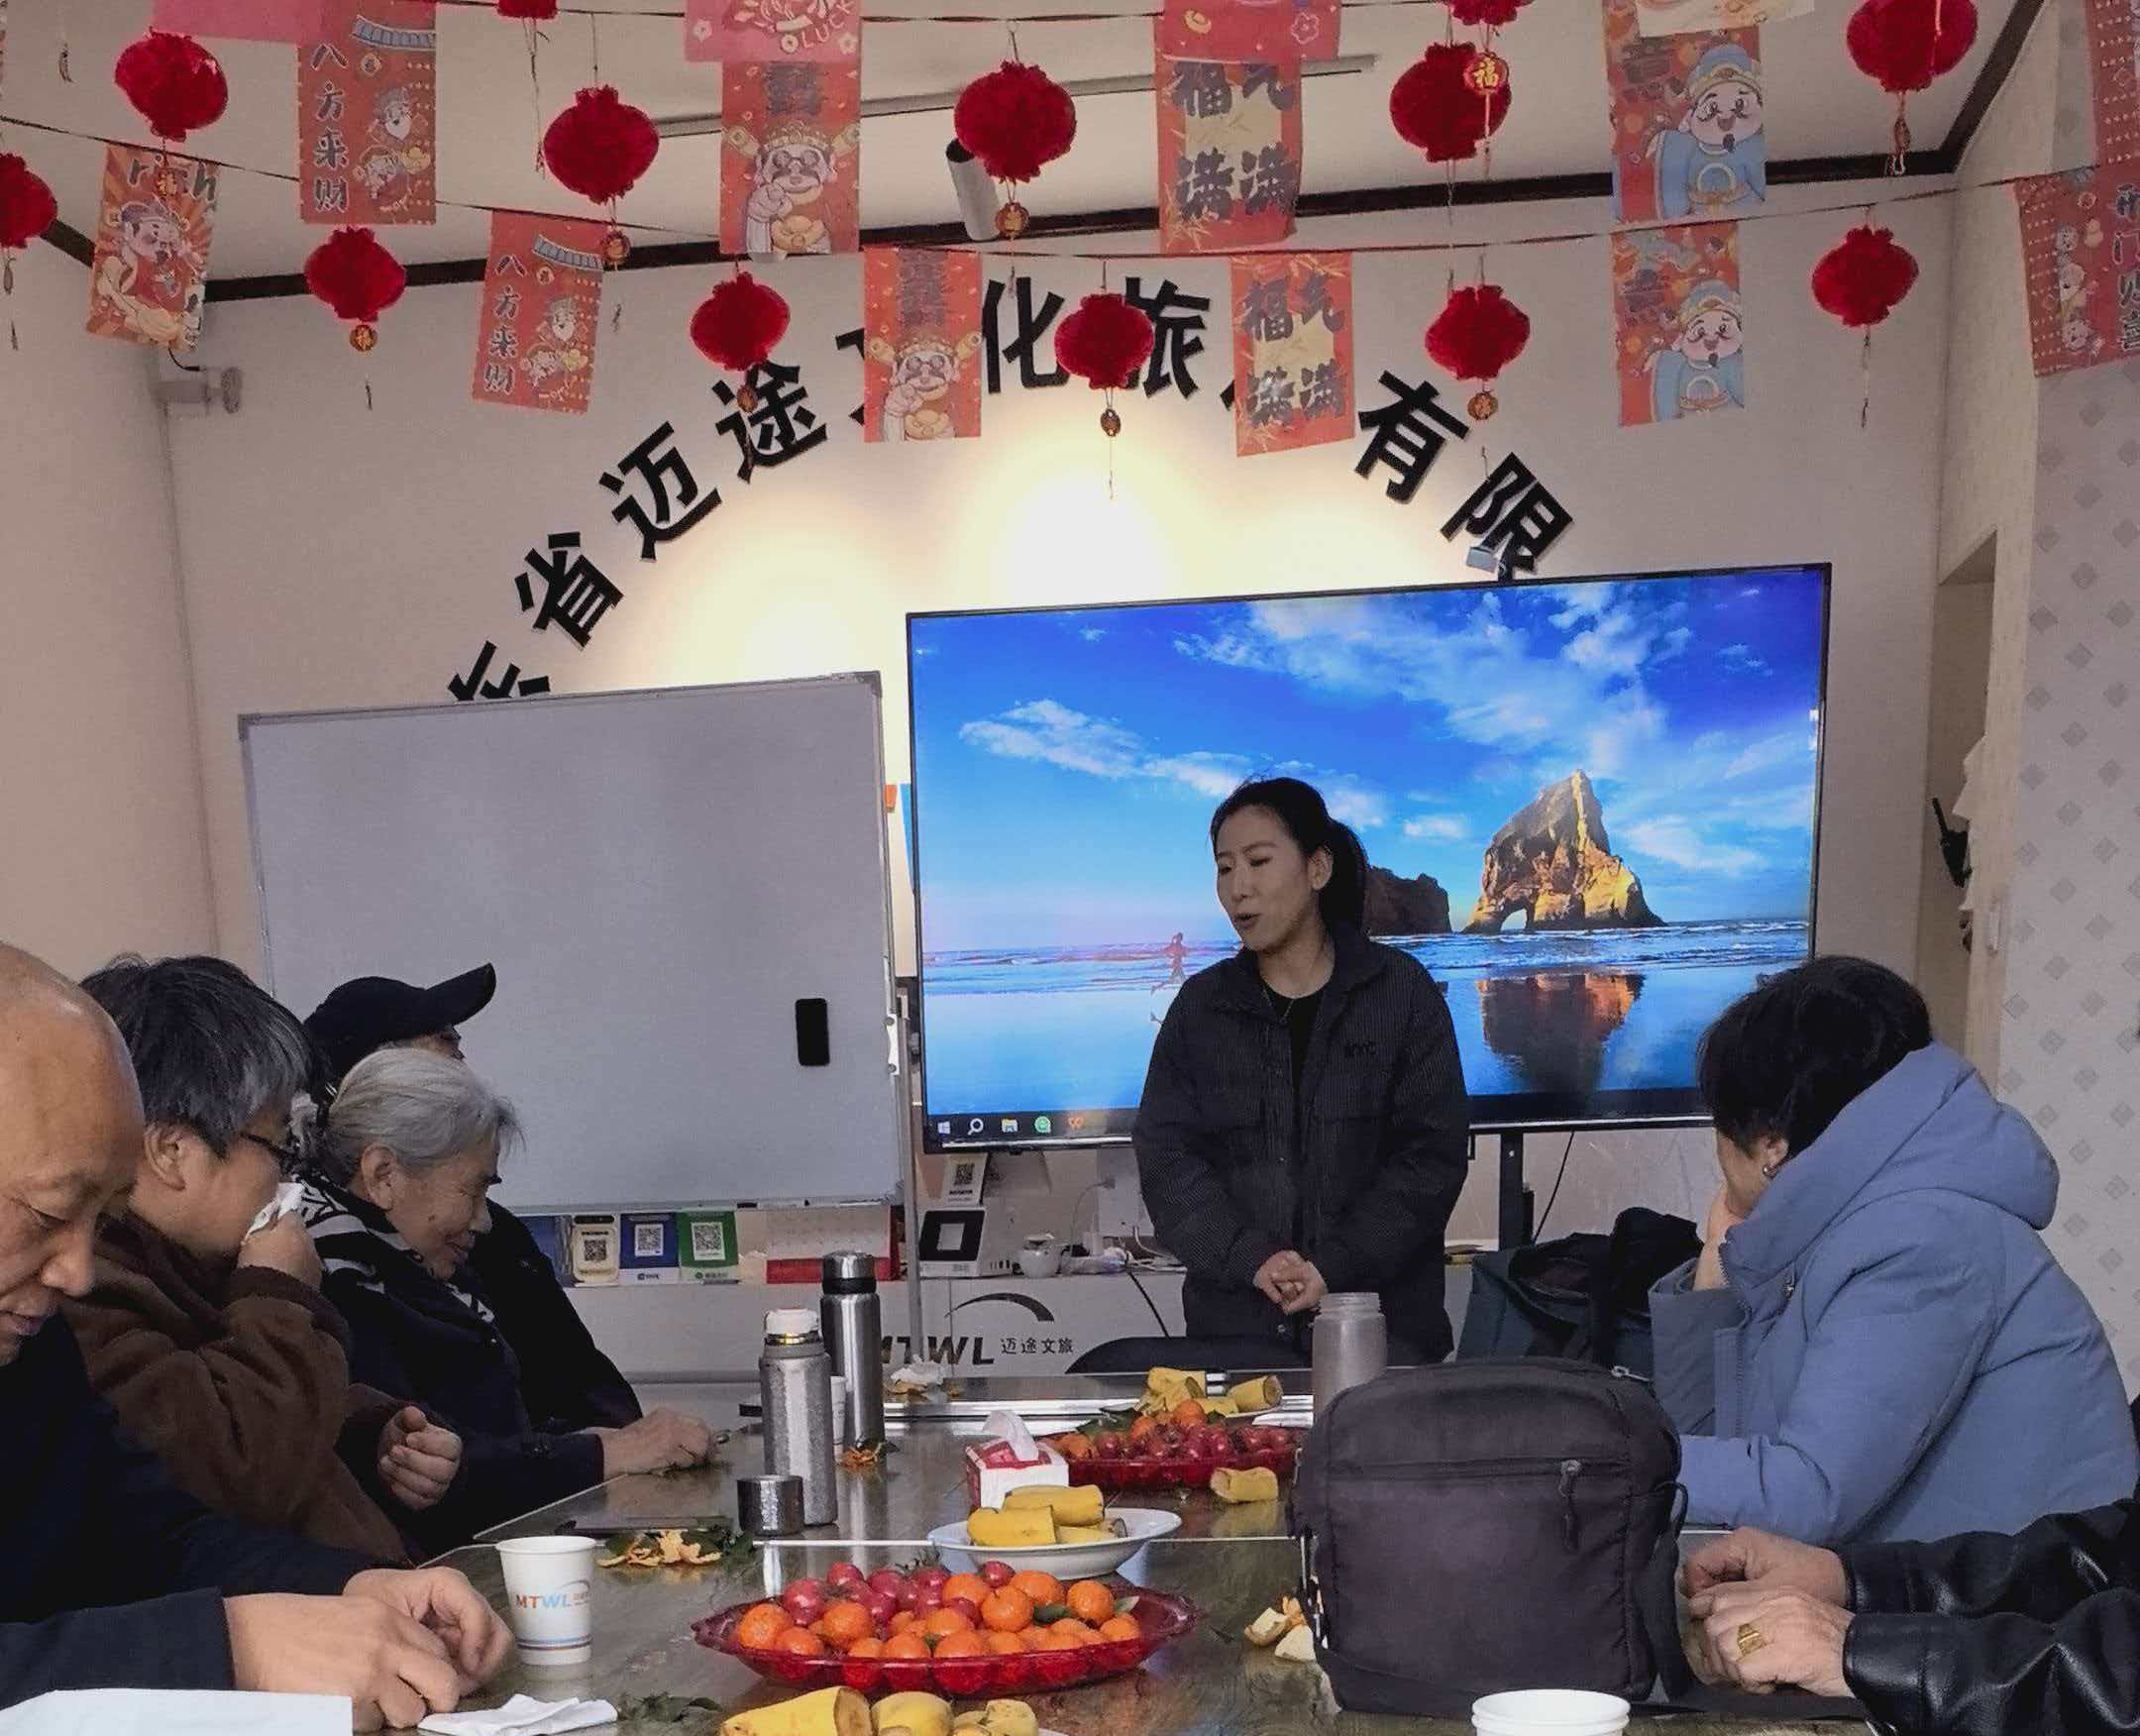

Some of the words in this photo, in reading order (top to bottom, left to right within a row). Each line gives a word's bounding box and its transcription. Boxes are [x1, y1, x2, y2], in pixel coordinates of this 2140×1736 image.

[311, 43, 349, 214] 八方来财
[1175, 142, 1300, 223] 满满
[482, 254, 528, 395] 八方来财
[1240, 271, 1347, 342] 福气
[1001, 1338, 1074, 1355] 迈途文旅
[515, 1594, 571, 1608] MTWL
